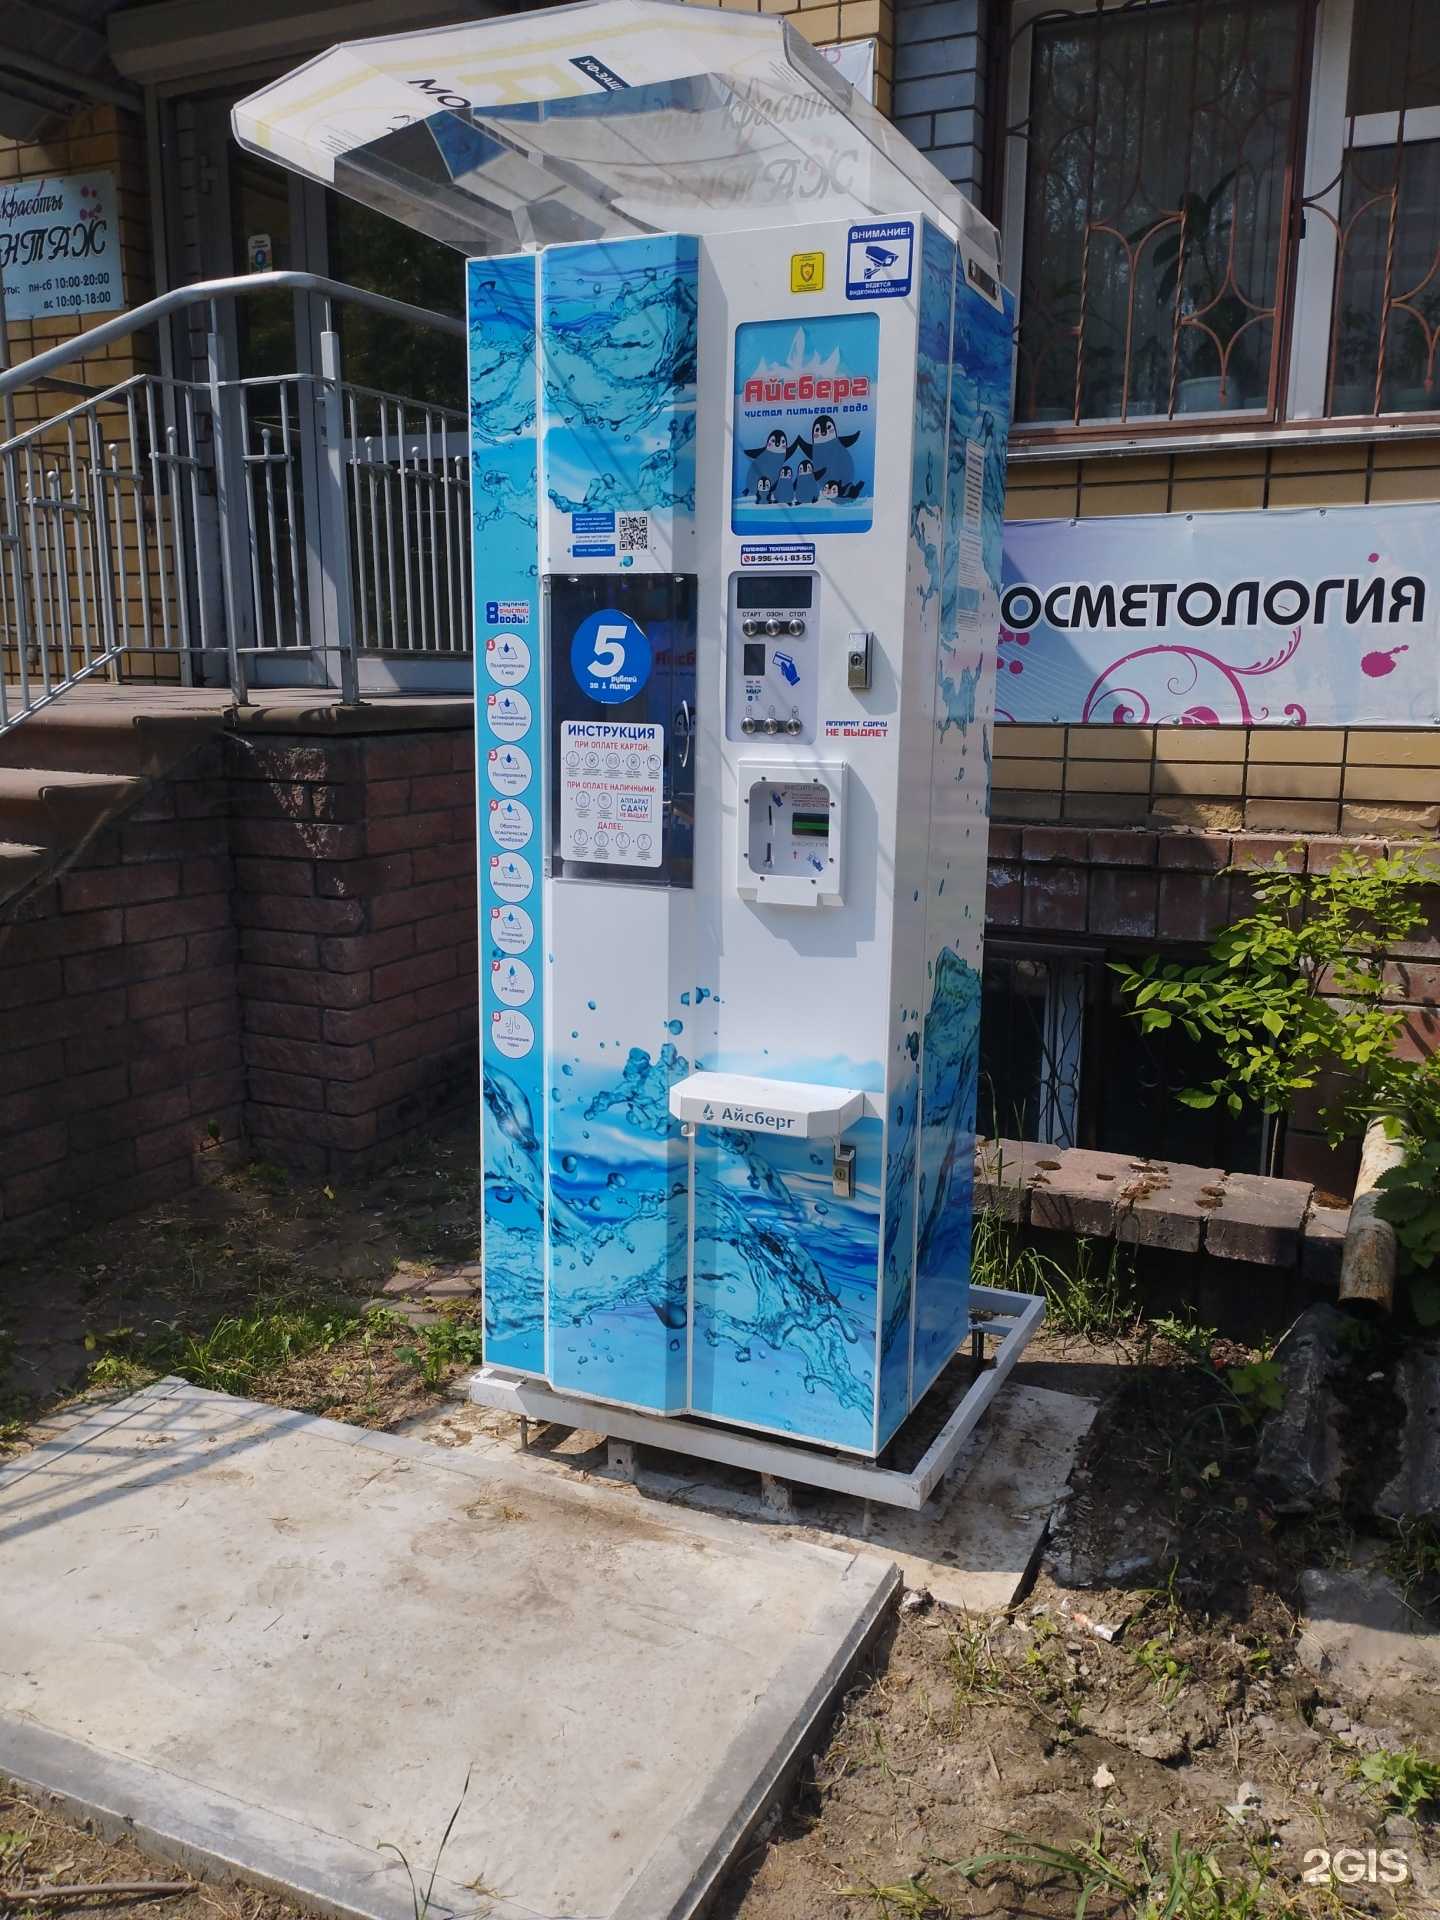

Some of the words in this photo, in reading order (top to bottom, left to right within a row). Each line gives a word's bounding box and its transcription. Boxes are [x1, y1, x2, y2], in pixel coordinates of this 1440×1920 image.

[851, 227, 910, 240] ВНИМАНИЕ!
[29, 280, 52, 293] пн-сб
[55, 272, 110, 289] 10:00-20:00
[865, 281, 892, 289] ВЕДЕТСЯ
[44, 300, 54, 309] вс
[56, 291, 111, 309] 10:00-18:00
[744, 374, 870, 404] Айсберг
[744, 409, 782, 418] чистая
[786, 406, 838, 415] питьевая
[843, 402, 868, 412] вода
[1001, 576, 1426, 629] ОСМЕТОЛОГИЯ
[487, 602, 498, 624] 8
[587, 625, 627, 678] 5
[611, 675, 637, 683] рублей
[609, 683, 631, 692] литр
[825, 720, 860, 728] АППАРАТ
[863, 720, 888, 728] СДАЧУ
[568, 724, 656, 740] ИНСТРУКЦИЯ
[825, 728, 839, 737] НЕ
[843, 728, 888, 737] ВЫДАЕТ
[575, 740, 589, 748] ПРИ
[591, 741, 618, 749] ОПЛАТЕ
[567, 781, 581, 789] ПРИ
[582, 782, 608, 790] ОПЛАТЕ
[620, 804, 648, 812] СДАЧУ
[597, 821, 624, 830] ДАЛЕЕ:
[721, 1107, 795, 1131] Айсберг
